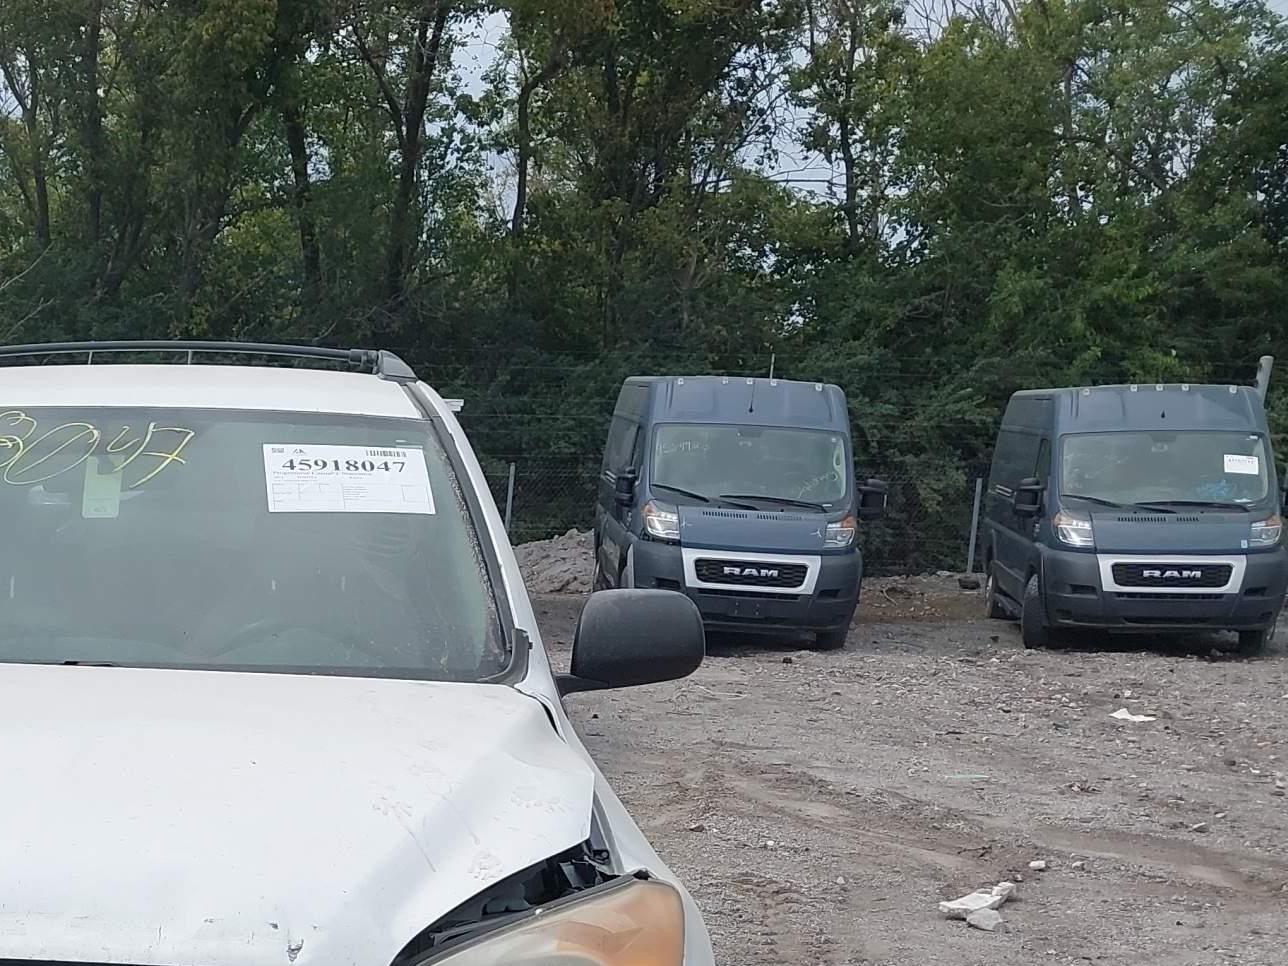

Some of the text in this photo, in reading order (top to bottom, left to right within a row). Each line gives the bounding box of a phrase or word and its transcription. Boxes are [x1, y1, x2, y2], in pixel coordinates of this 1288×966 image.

[282, 459, 406, 473] 45918047
[723, 567, 779, 577] RAM
[1143, 570, 1202, 578] RAM
